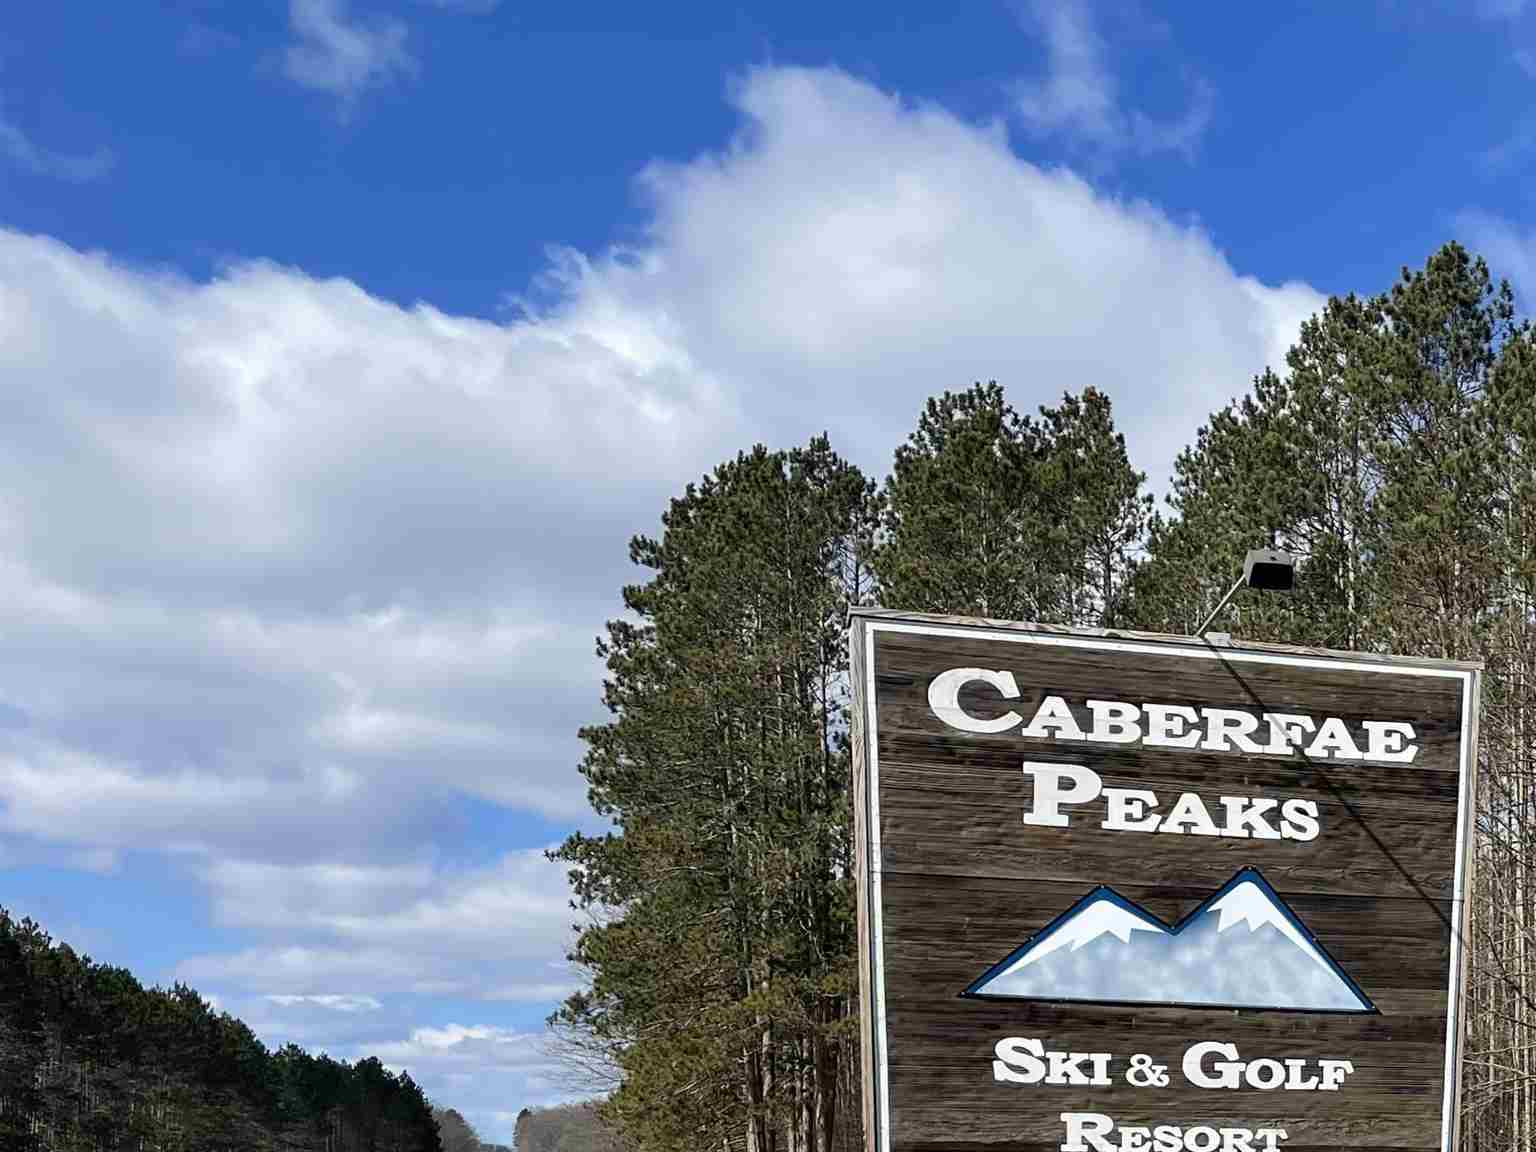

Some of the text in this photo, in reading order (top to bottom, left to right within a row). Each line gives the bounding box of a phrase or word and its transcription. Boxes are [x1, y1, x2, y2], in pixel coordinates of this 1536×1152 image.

[927, 667, 1418, 764] CABERFAE
[1022, 761, 1320, 842] PEAKS
[992, 1037, 1354, 1091] SKI & GOLF
